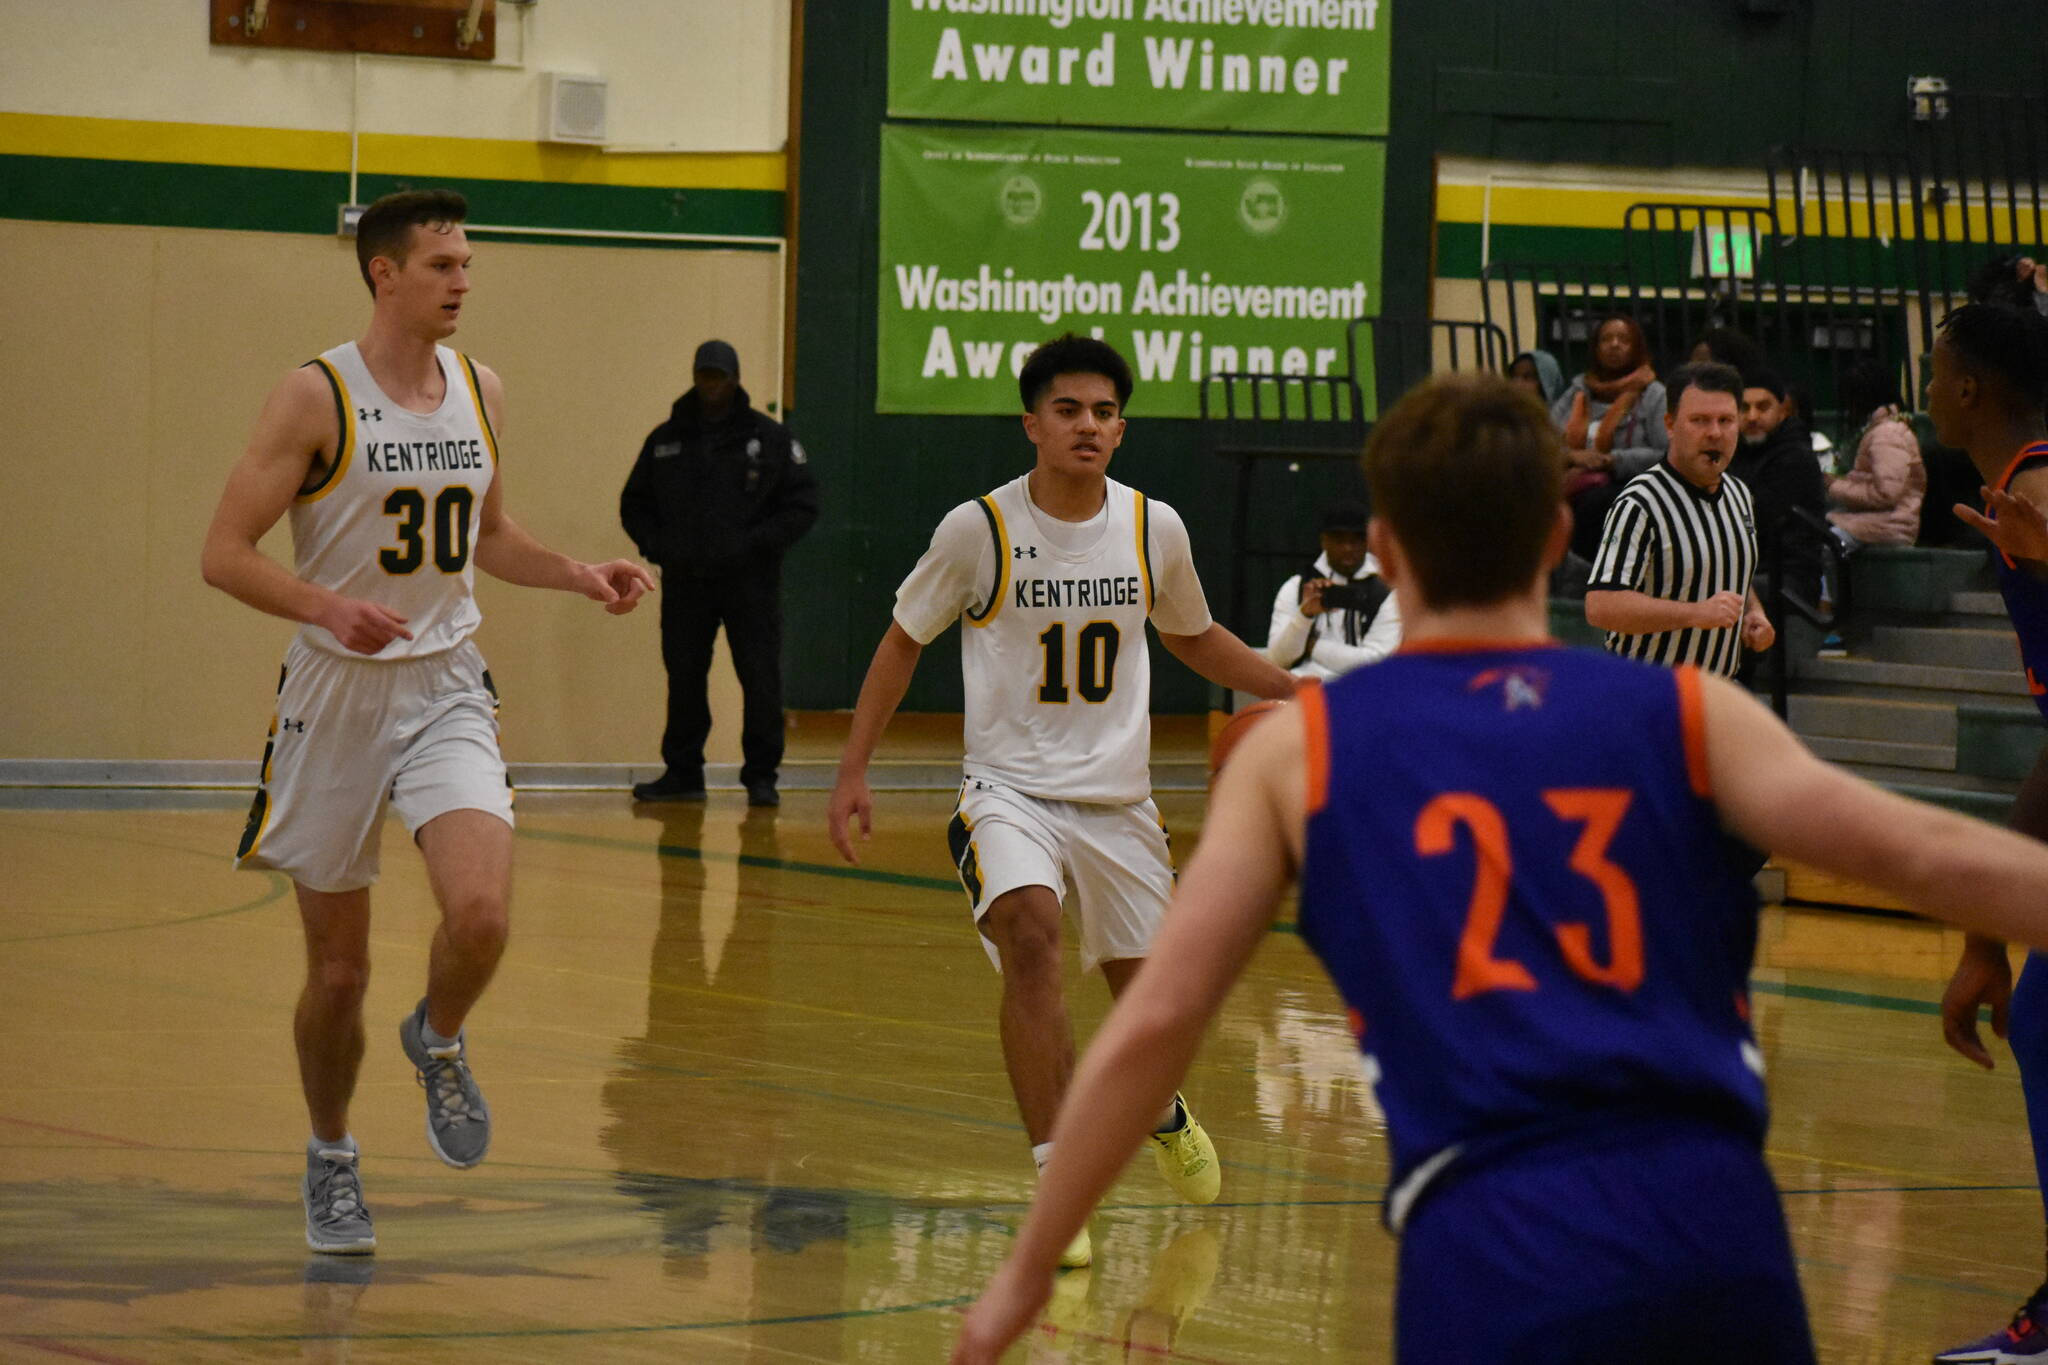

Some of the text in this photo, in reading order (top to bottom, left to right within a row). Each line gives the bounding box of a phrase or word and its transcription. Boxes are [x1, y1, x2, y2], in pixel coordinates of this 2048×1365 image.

[931, 28, 1348, 95] Award Winner
[1079, 189, 1181, 252] 2013
[1711, 231, 1753, 273] EIT
[895, 264, 1367, 324] Washington Achievement
[921, 326, 1337, 384] Awa Winner
[367, 439, 483, 472] KENTRIDGE
[377, 484, 477, 577] 30
[1015, 576, 1139, 608] KENTRIDGE
[1037, 619, 1121, 704] 10
[1413, 787, 1646, 1001] 23
